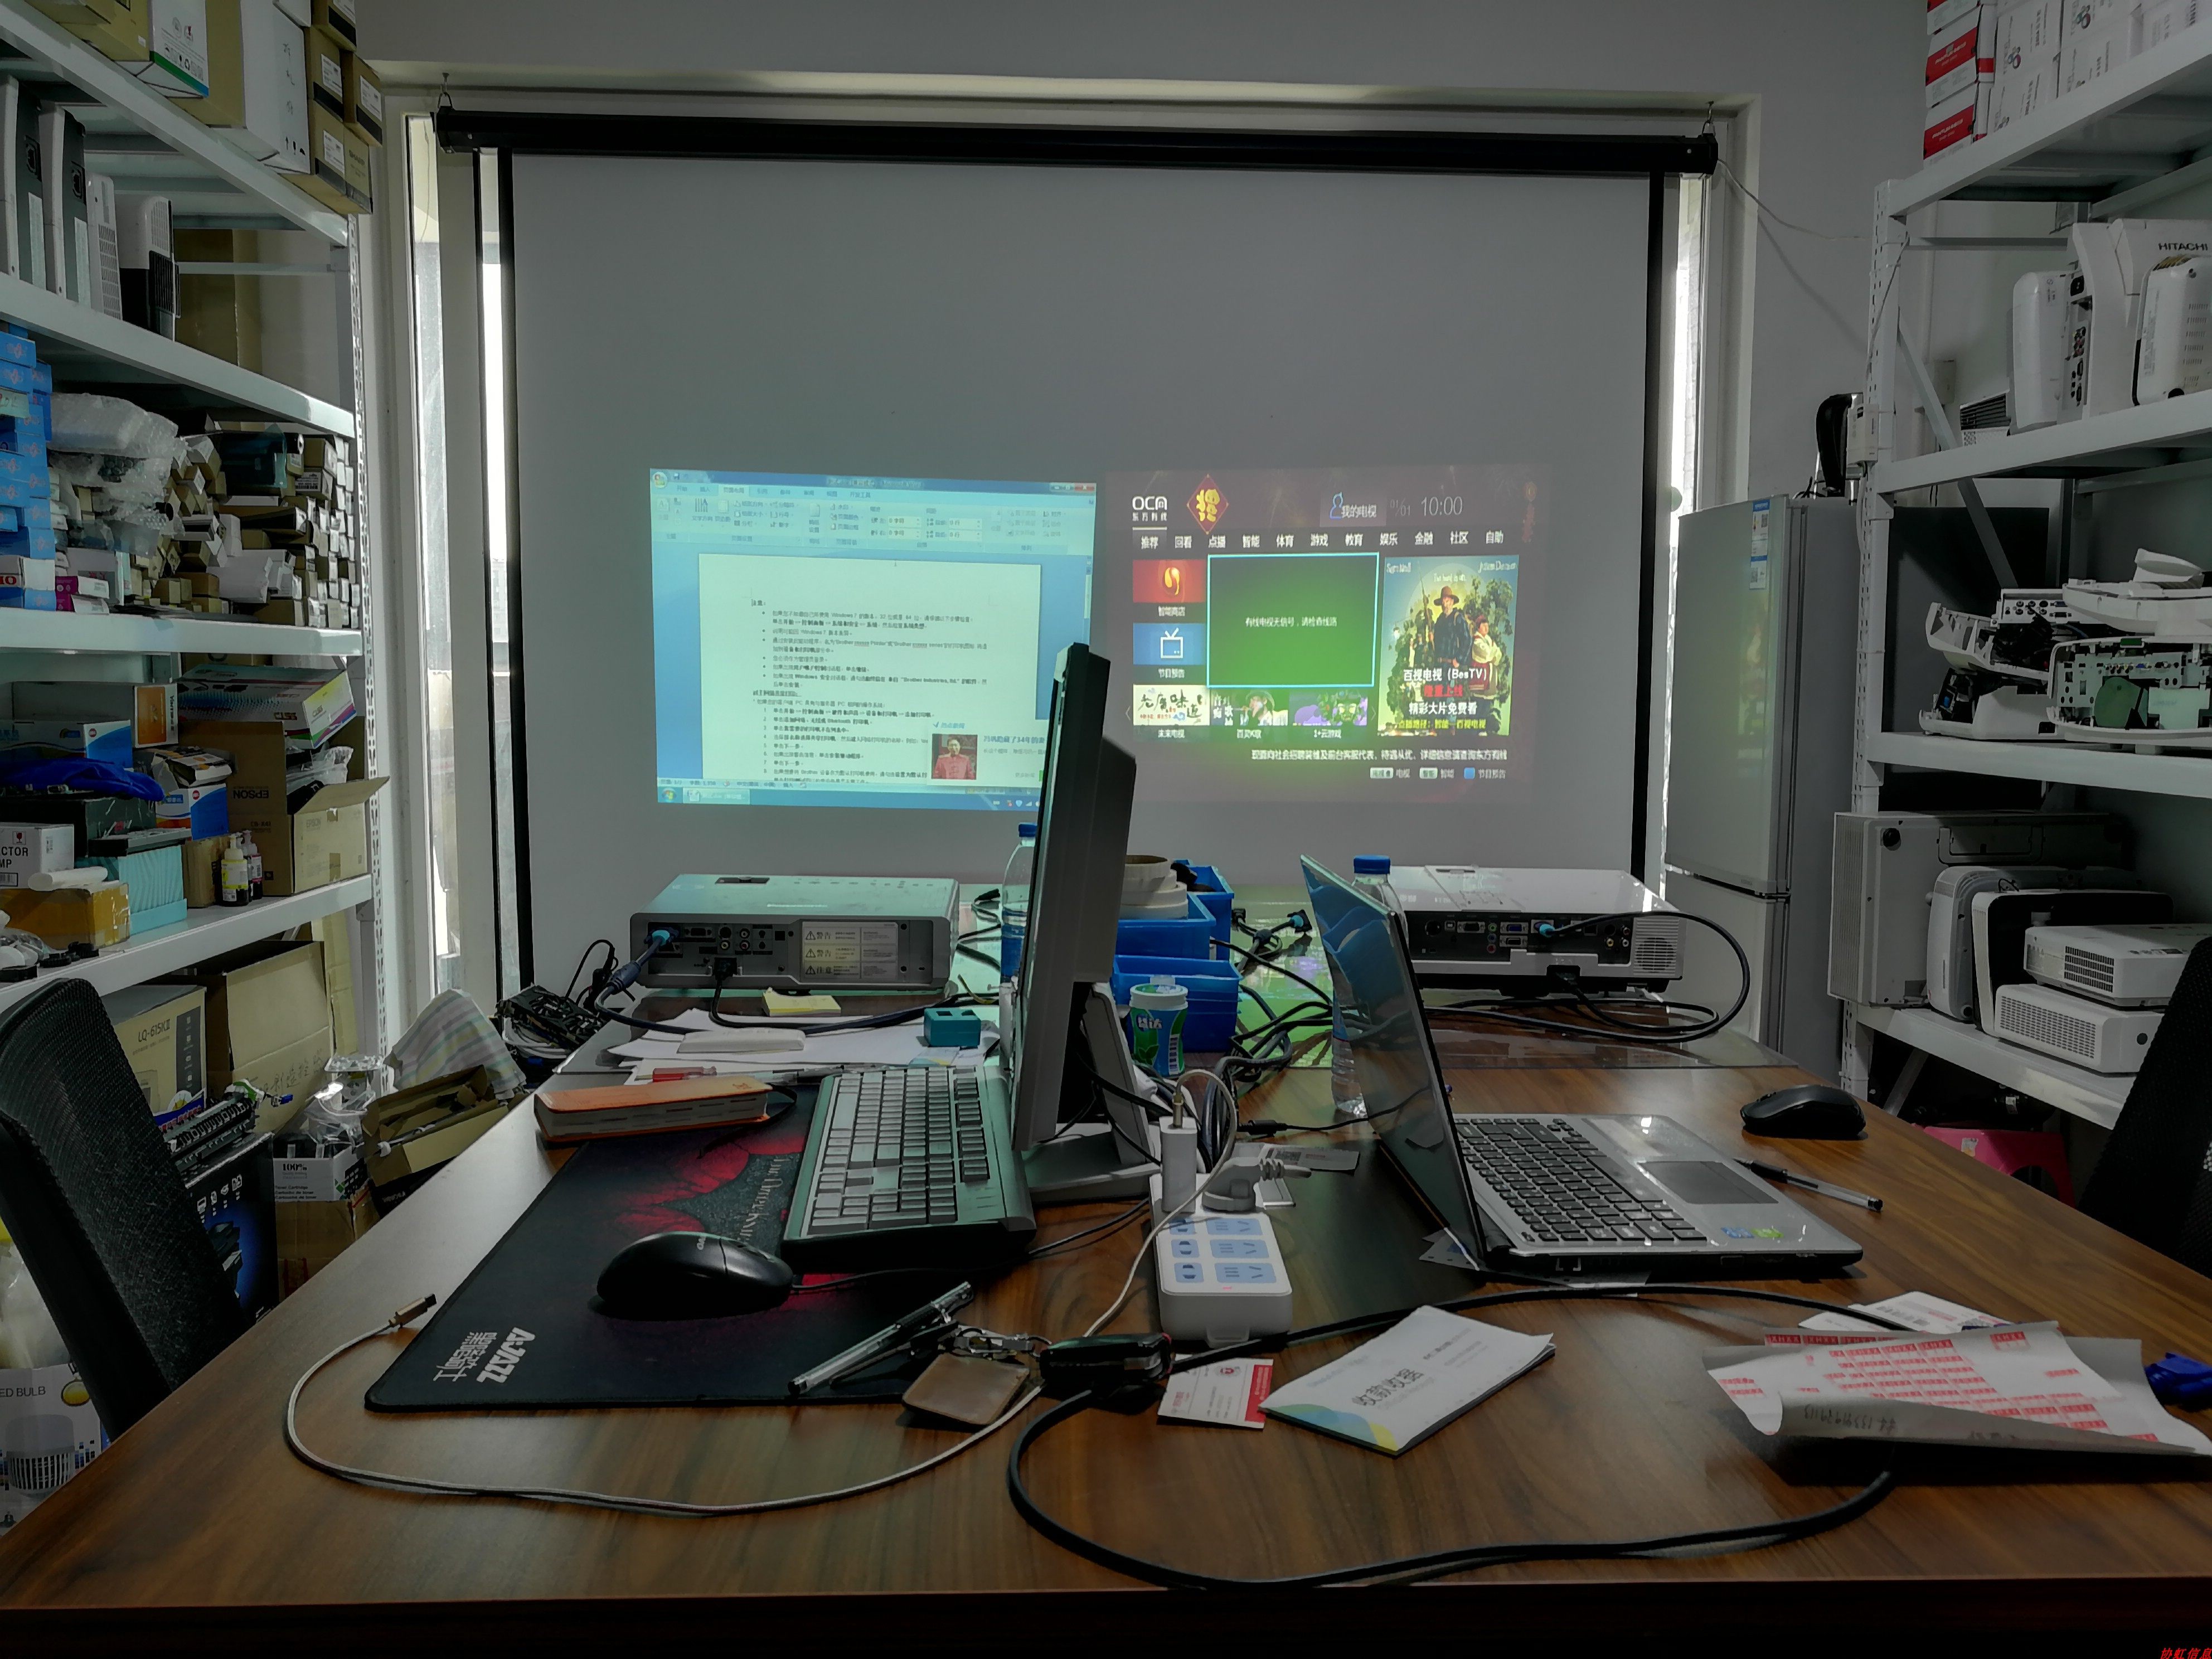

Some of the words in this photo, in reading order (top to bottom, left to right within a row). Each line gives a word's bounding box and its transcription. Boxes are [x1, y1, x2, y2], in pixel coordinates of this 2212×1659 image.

[2158, 242, 2208, 251] HITACHI
[1341, 505, 1377, 518] 我的电视
[1421, 496, 1463, 516] 10:00
[1141, 536, 1158, 549] 推荐
[1175, 536, 1192, 549] 回看
[1277, 534, 1294, 547] 体育
[1311, 533, 1328, 547] 游戏
[1345, 533, 1363, 546] 教育
[1380, 532, 1398, 545] 娱乐
[1414, 532, 1433, 545] 金融
[1450, 531, 1469, 545] 社区
[1486, 530, 1503, 545] 自助
[1409, 701, 1477, 715] 精彩大片免费看
[233, 790, 269, 799] EPSON
[306, 818, 321, 828] EPSON
[16, 1386, 46, 1397] BULB
